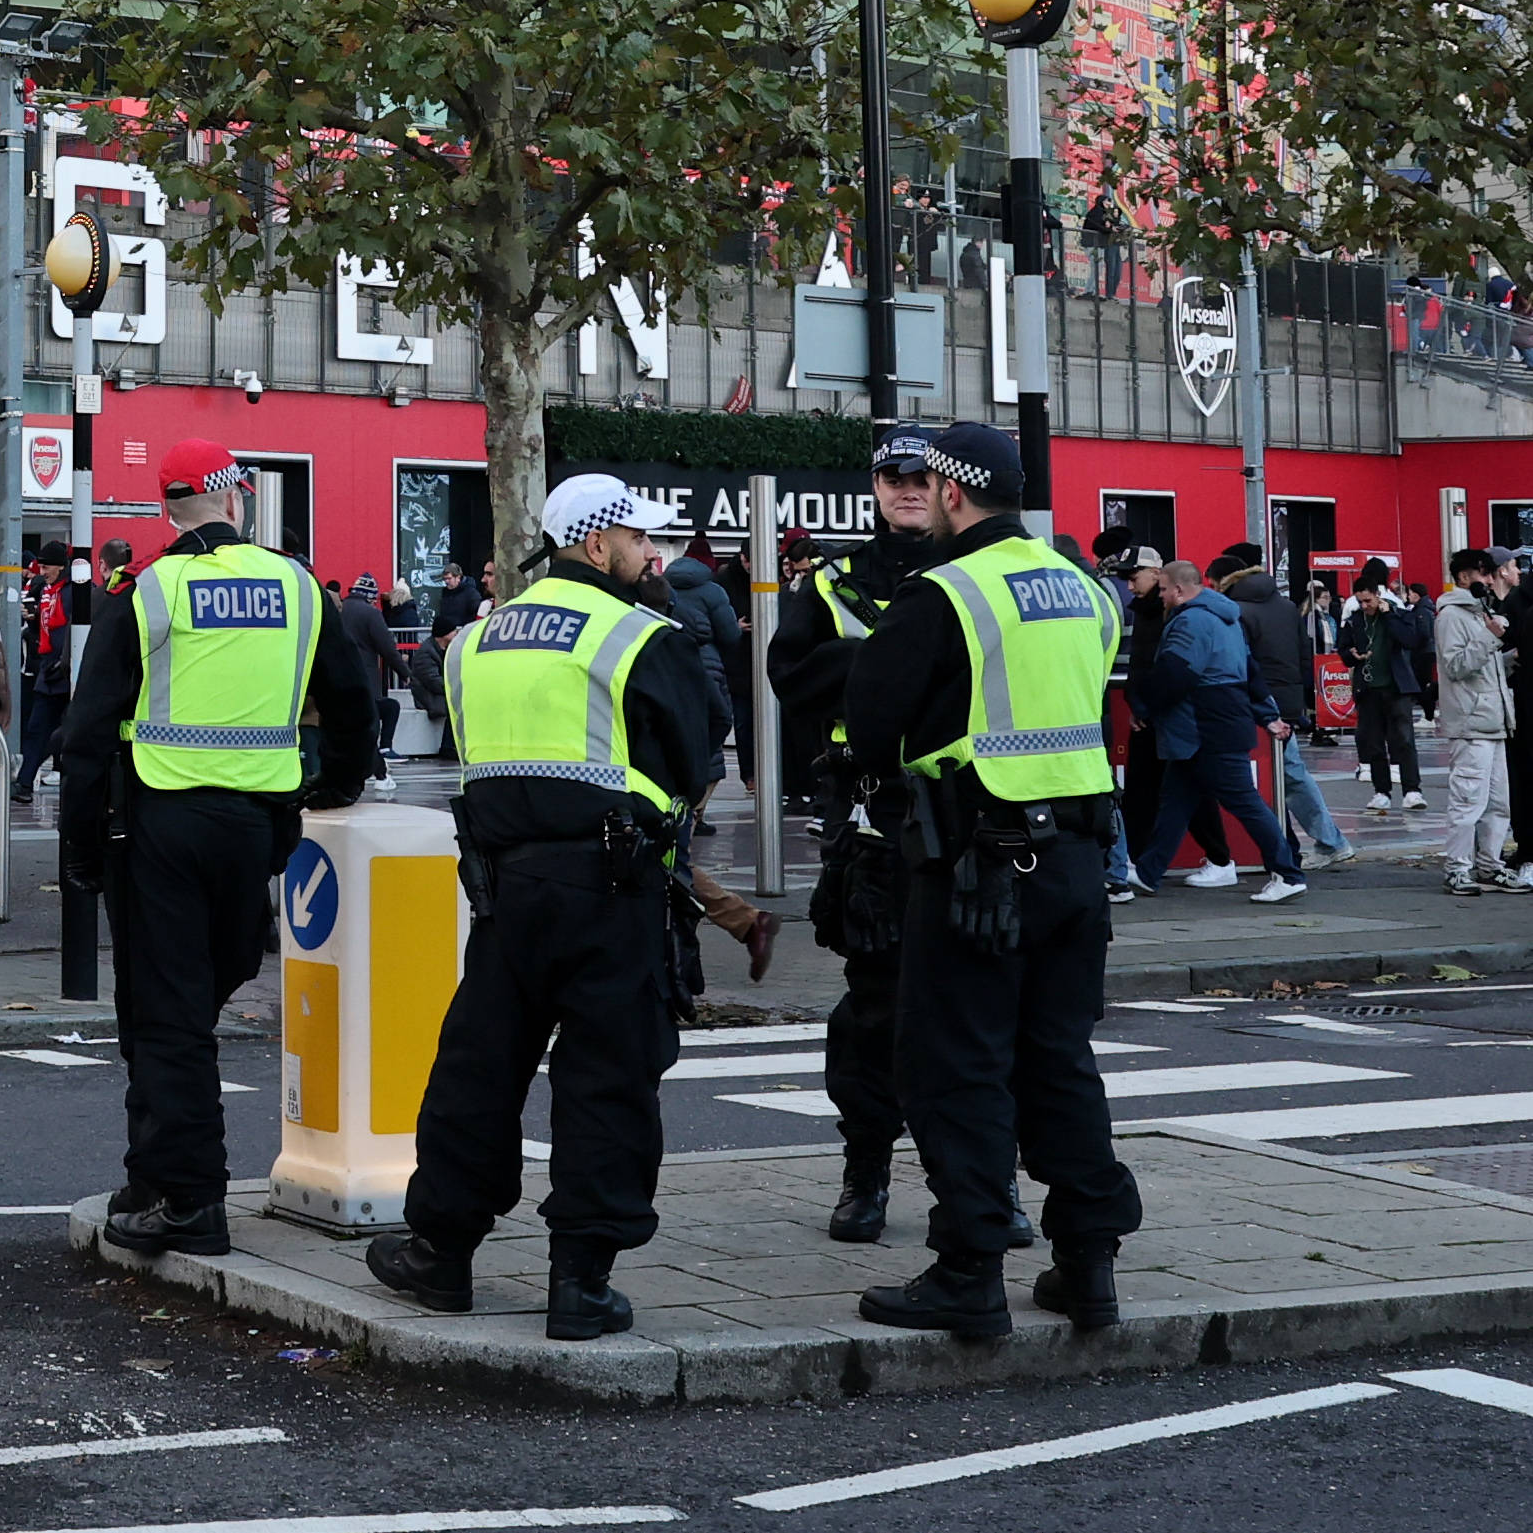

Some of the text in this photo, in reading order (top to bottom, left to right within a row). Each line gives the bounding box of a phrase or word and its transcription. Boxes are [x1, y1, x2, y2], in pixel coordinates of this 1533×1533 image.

[1181, 302, 1228, 326] Arsenal
[708, 487, 875, 531] AMOUR
[194, 586, 283, 619] POLICE
[1012, 576, 1091, 612] POLICE
[482, 611, 582, 644] POLICE
[1323, 670, 1350, 680] Arsen
